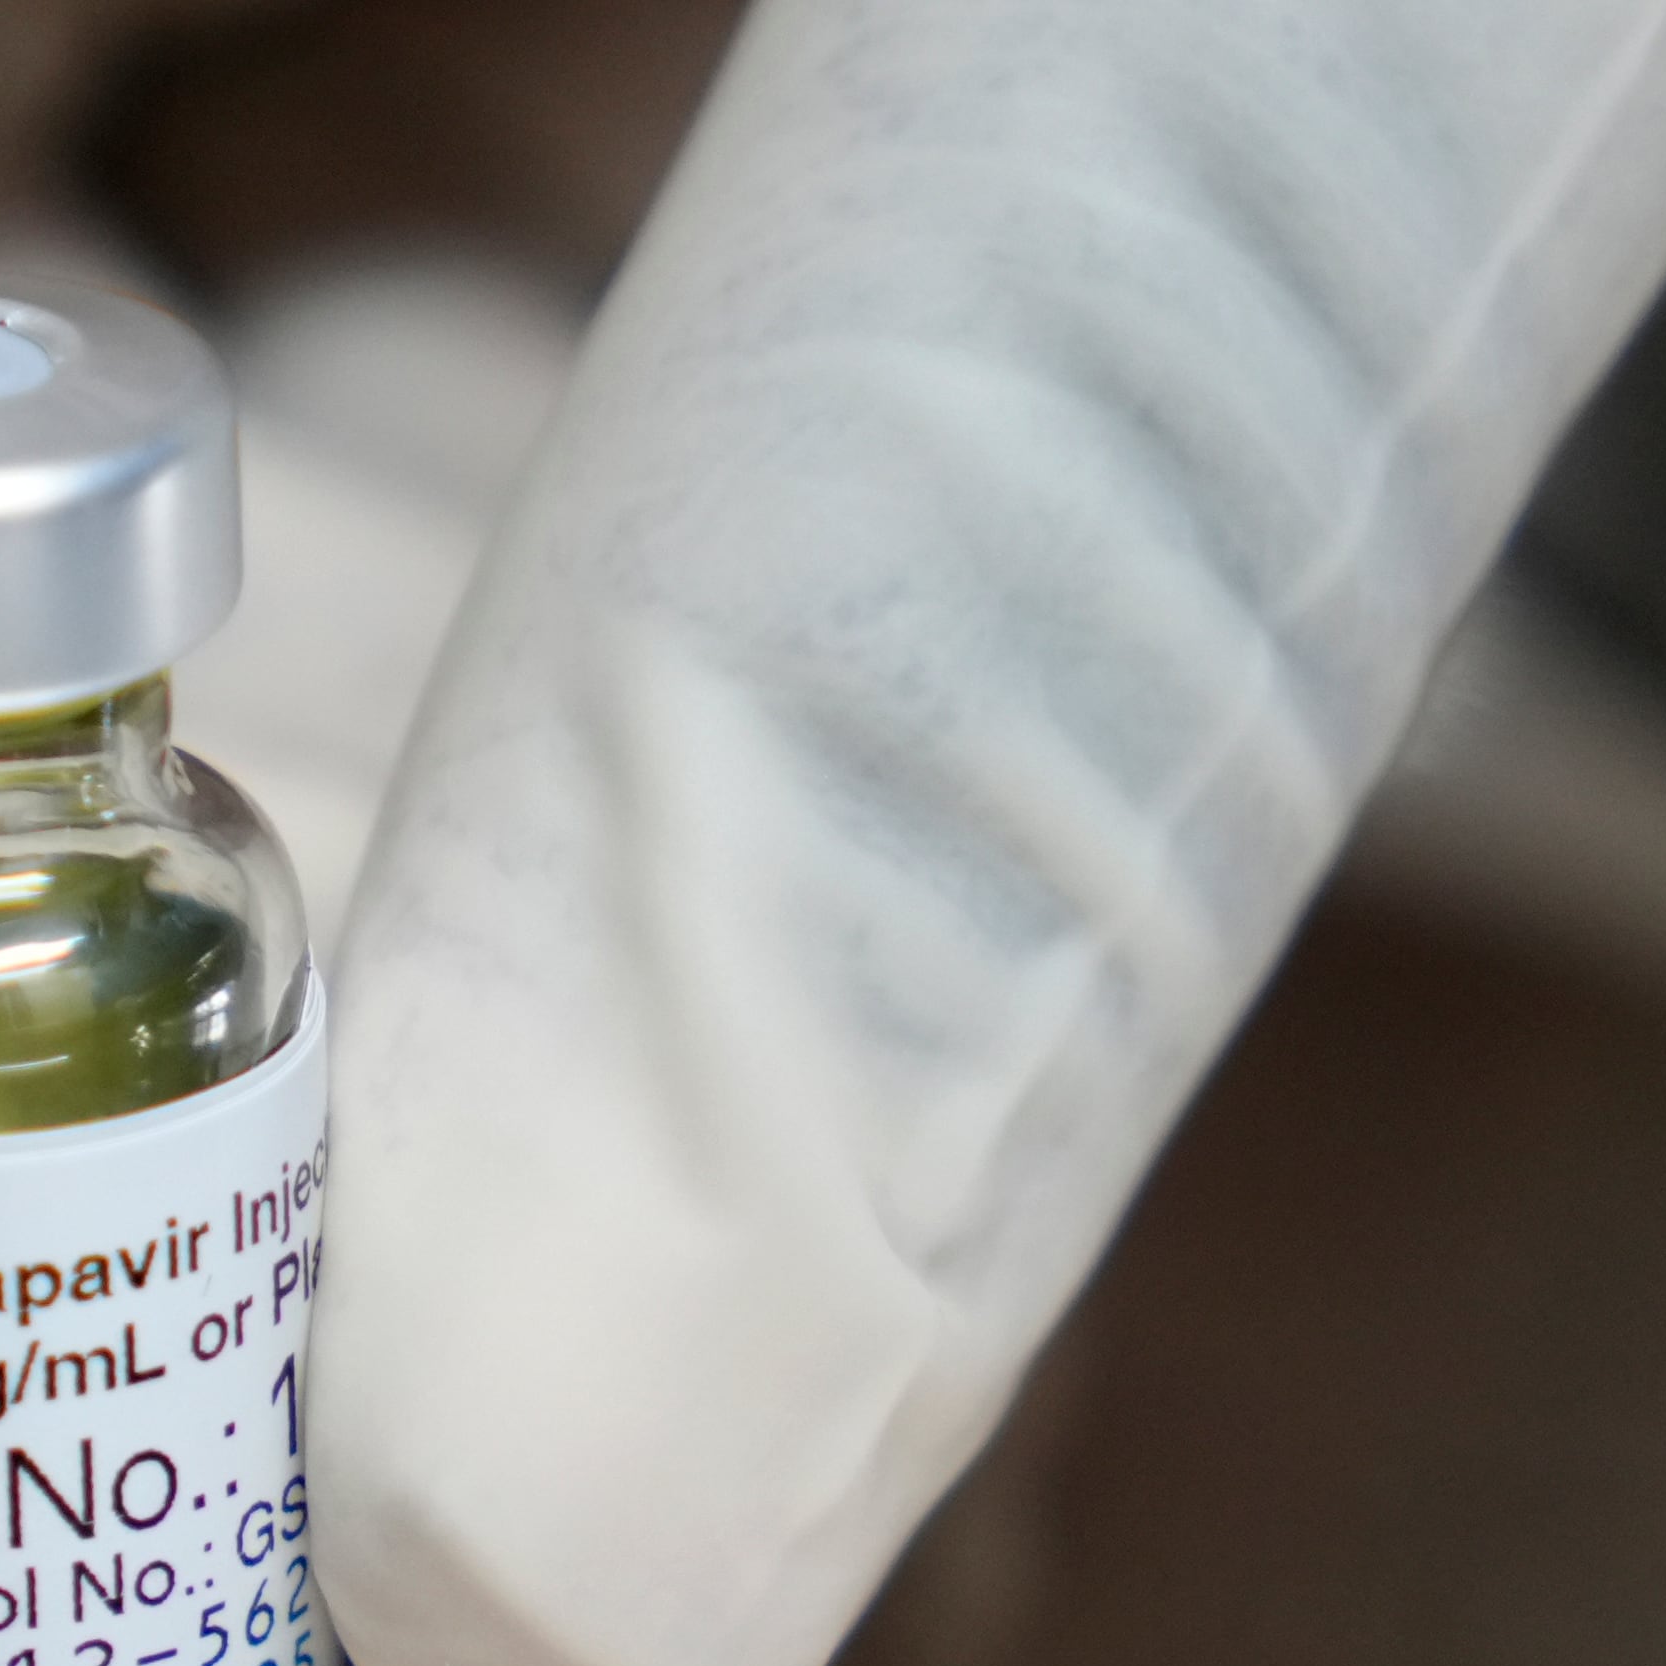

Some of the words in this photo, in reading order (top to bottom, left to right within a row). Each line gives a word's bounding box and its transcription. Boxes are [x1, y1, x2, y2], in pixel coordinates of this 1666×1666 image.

[191, 1294, 254, 1362] or
[7, 1420, 239, 1550] No.:
[72, 1540, 215, 1622] No.:
